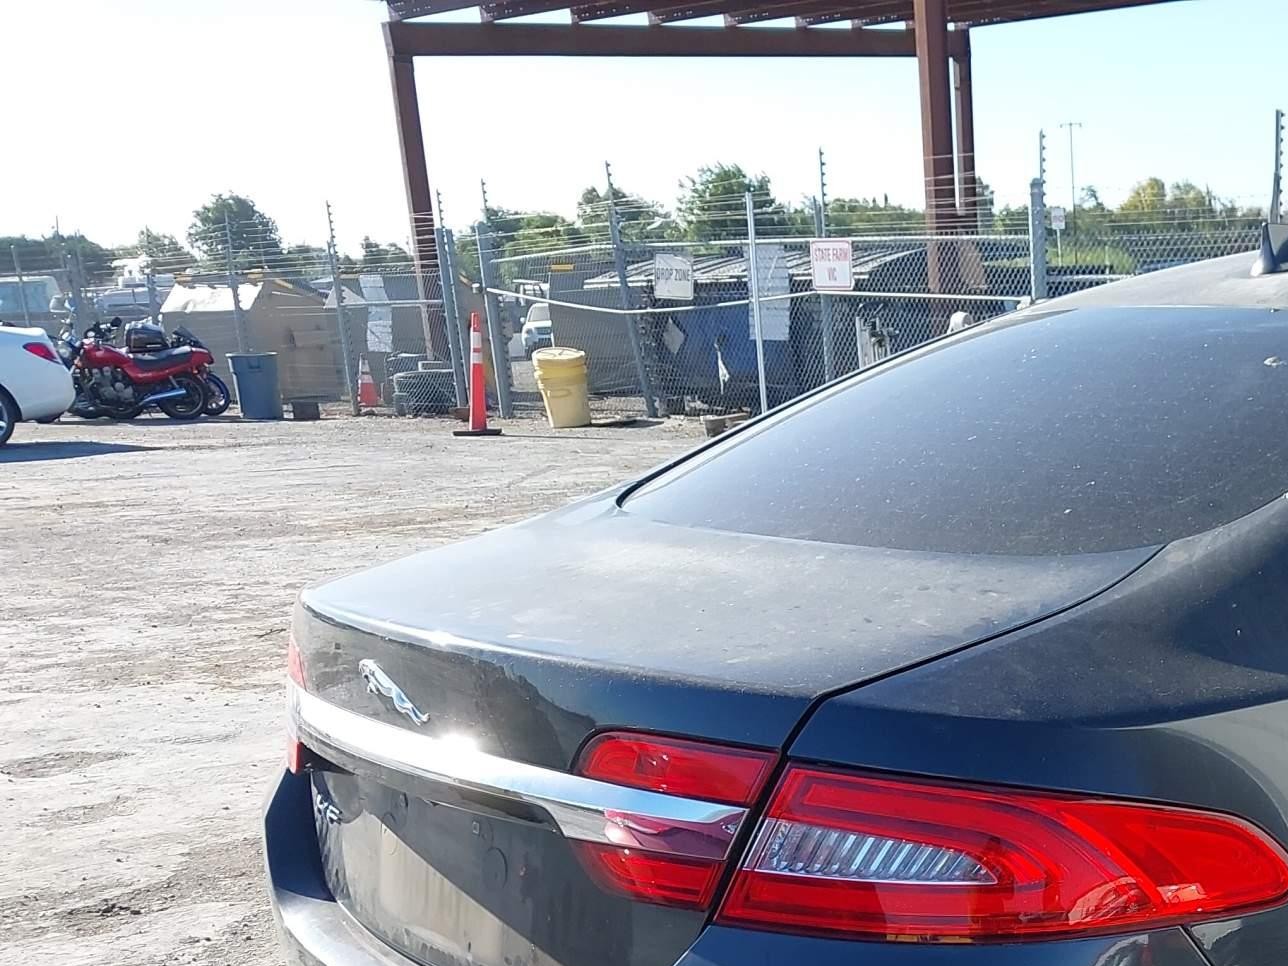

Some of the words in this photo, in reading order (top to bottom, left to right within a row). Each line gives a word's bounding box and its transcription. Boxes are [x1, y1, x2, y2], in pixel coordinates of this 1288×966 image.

[814, 247, 832, 262] STATE
[832, 247, 849, 262] FARM
[655, 267, 674, 281] DROP
[674, 268, 691, 282] ZONE
